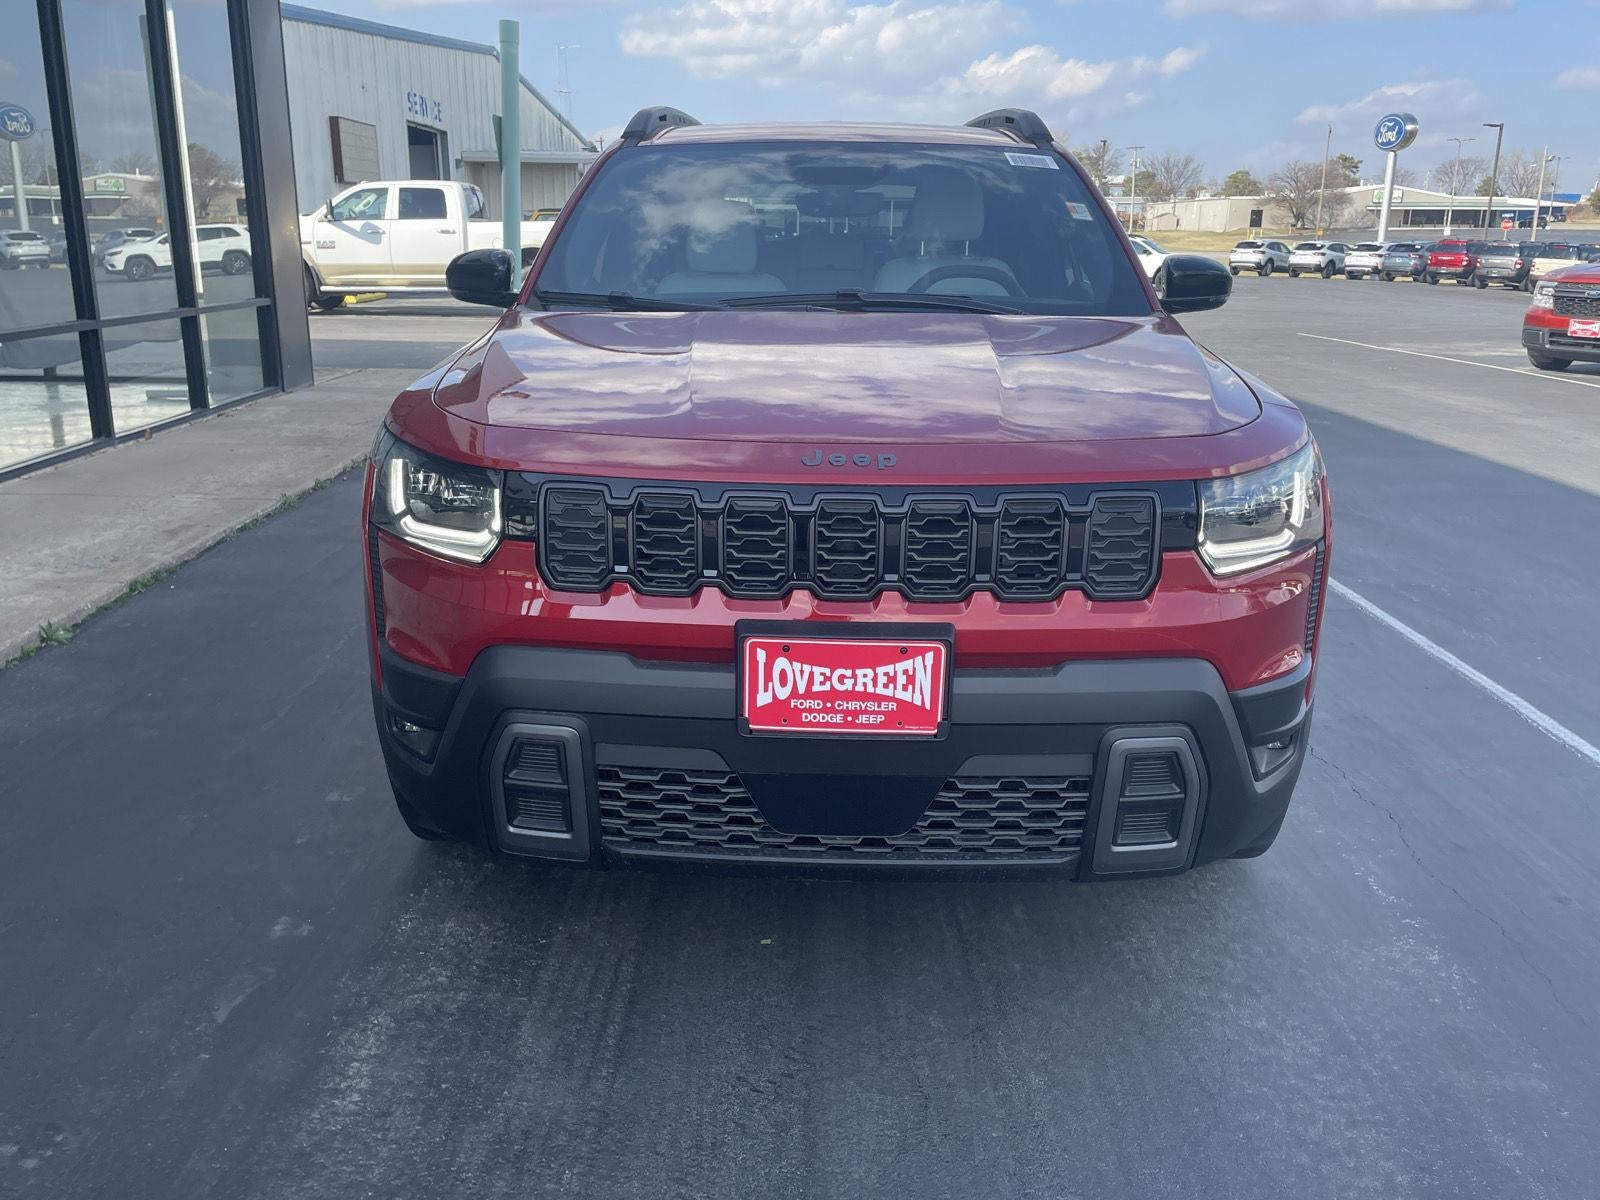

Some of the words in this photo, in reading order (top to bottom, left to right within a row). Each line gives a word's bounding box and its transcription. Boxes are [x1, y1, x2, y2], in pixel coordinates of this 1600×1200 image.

[406, 90, 442, 123] SERVCE
[1377, 121, 1399, 143] Ford
[801, 449, 897, 470] Jeep
[756, 647, 934, 710] LOVEGREEN
[791, 700, 823, 709] FORD
[835, 701, 897, 711] CHRYSLER
[802, 713, 844, 722] DODGE
[855, 714, 885, 724] JEEP
